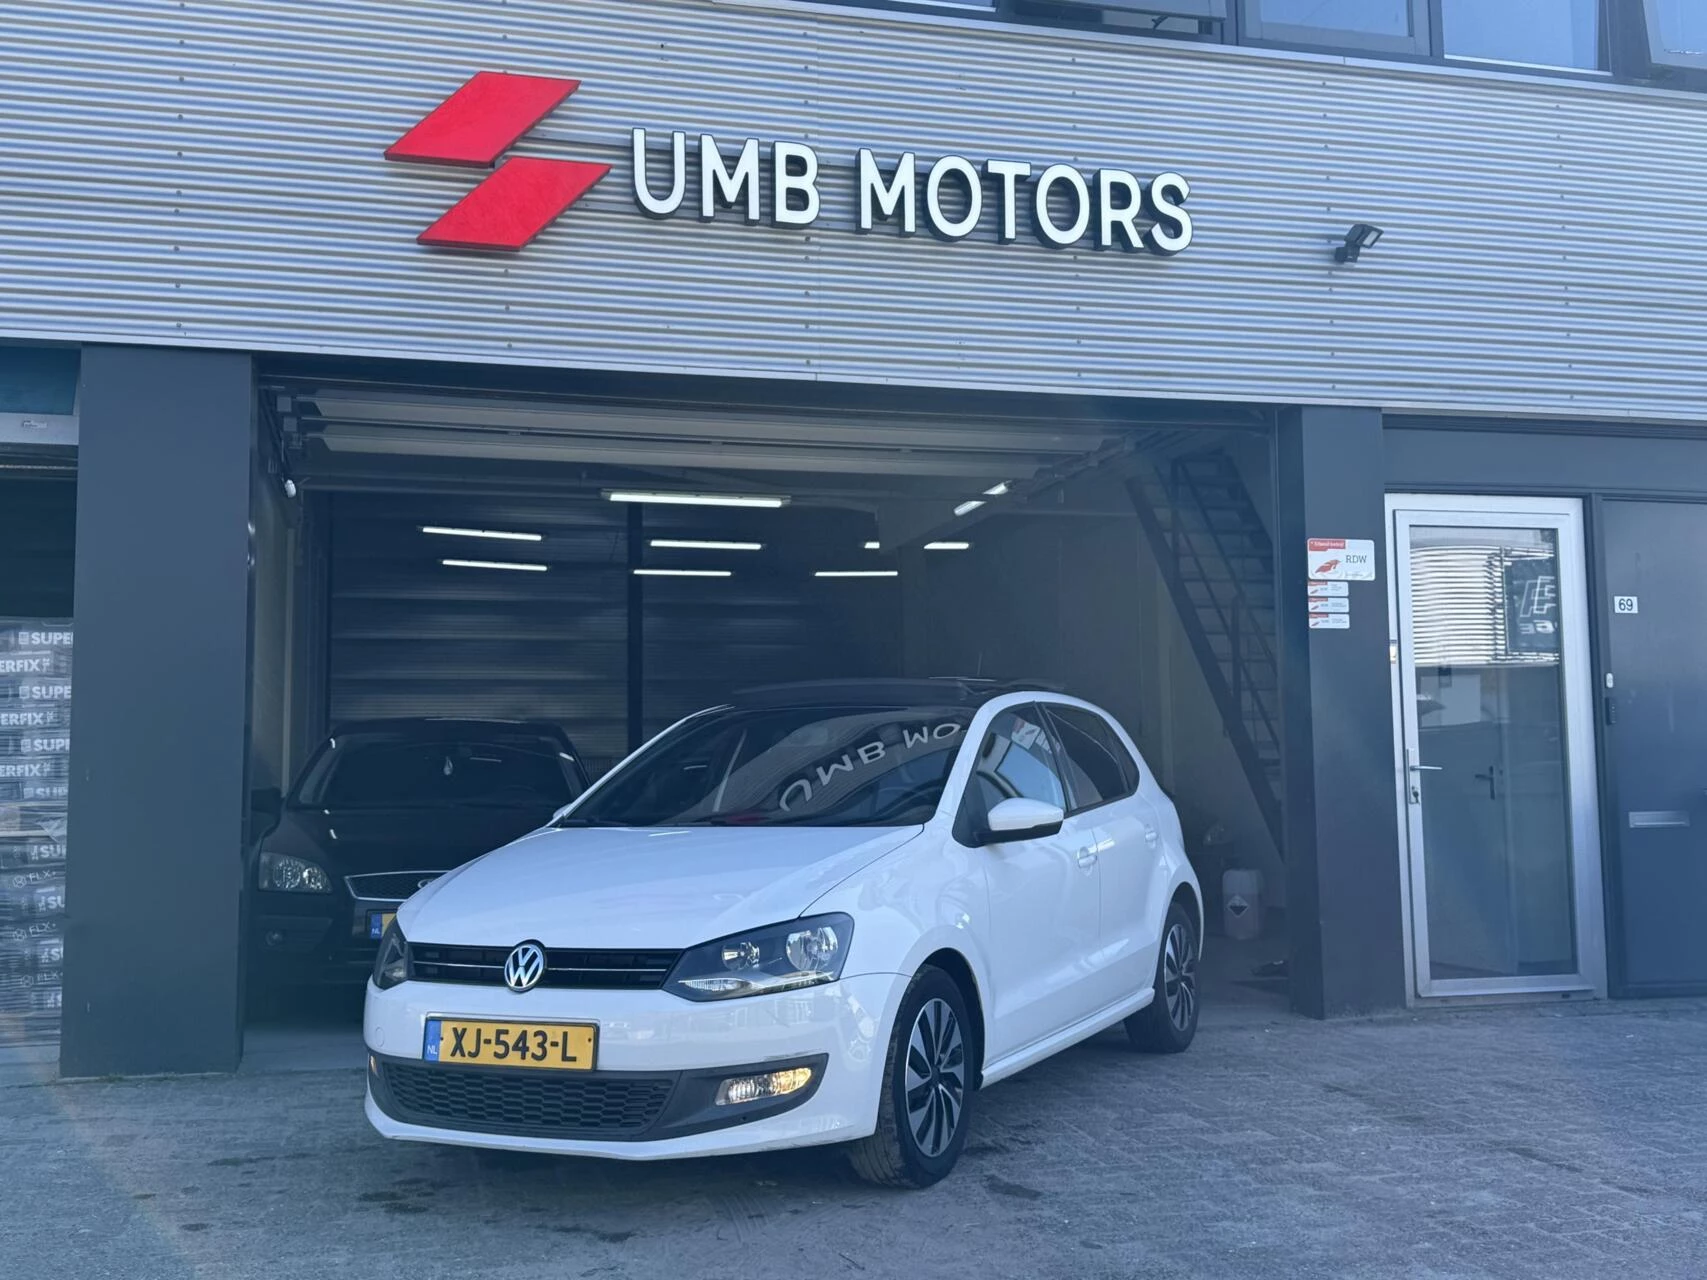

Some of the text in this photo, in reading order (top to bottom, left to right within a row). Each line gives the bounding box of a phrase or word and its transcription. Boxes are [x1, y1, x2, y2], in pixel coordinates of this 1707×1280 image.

[632, 128, 1194, 255] UMB MOTORS
[1345, 555, 1367, 564] RDW
[1618, 598, 1633, 611] 69
[31, 631, 74, 645] SUPE
[0, 712, 44, 725] ERFIX
[427, 1027, 577, 1063] NL XJ-543-L
